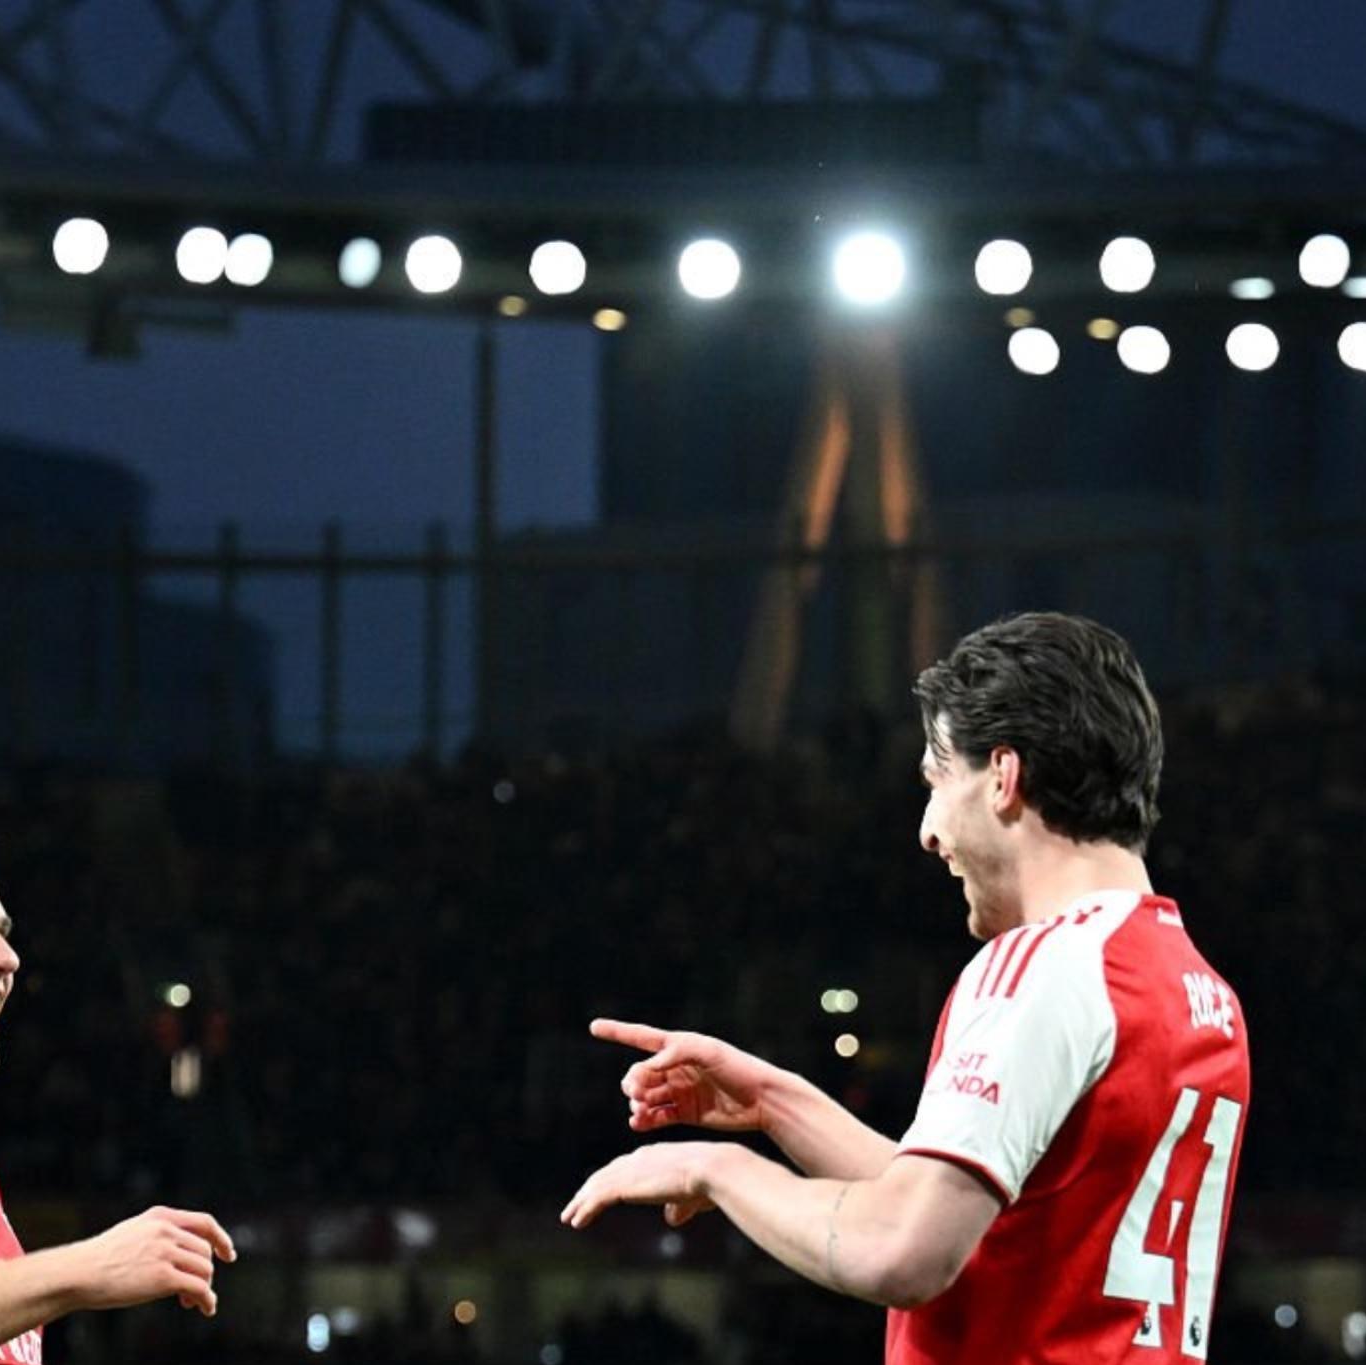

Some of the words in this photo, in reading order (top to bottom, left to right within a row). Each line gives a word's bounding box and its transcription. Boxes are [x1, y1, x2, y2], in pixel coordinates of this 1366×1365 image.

[1183, 971, 1235, 1040] RICE
[953, 1075, 1000, 1105] NDA
[1102, 1087, 1241, 1361] 41
